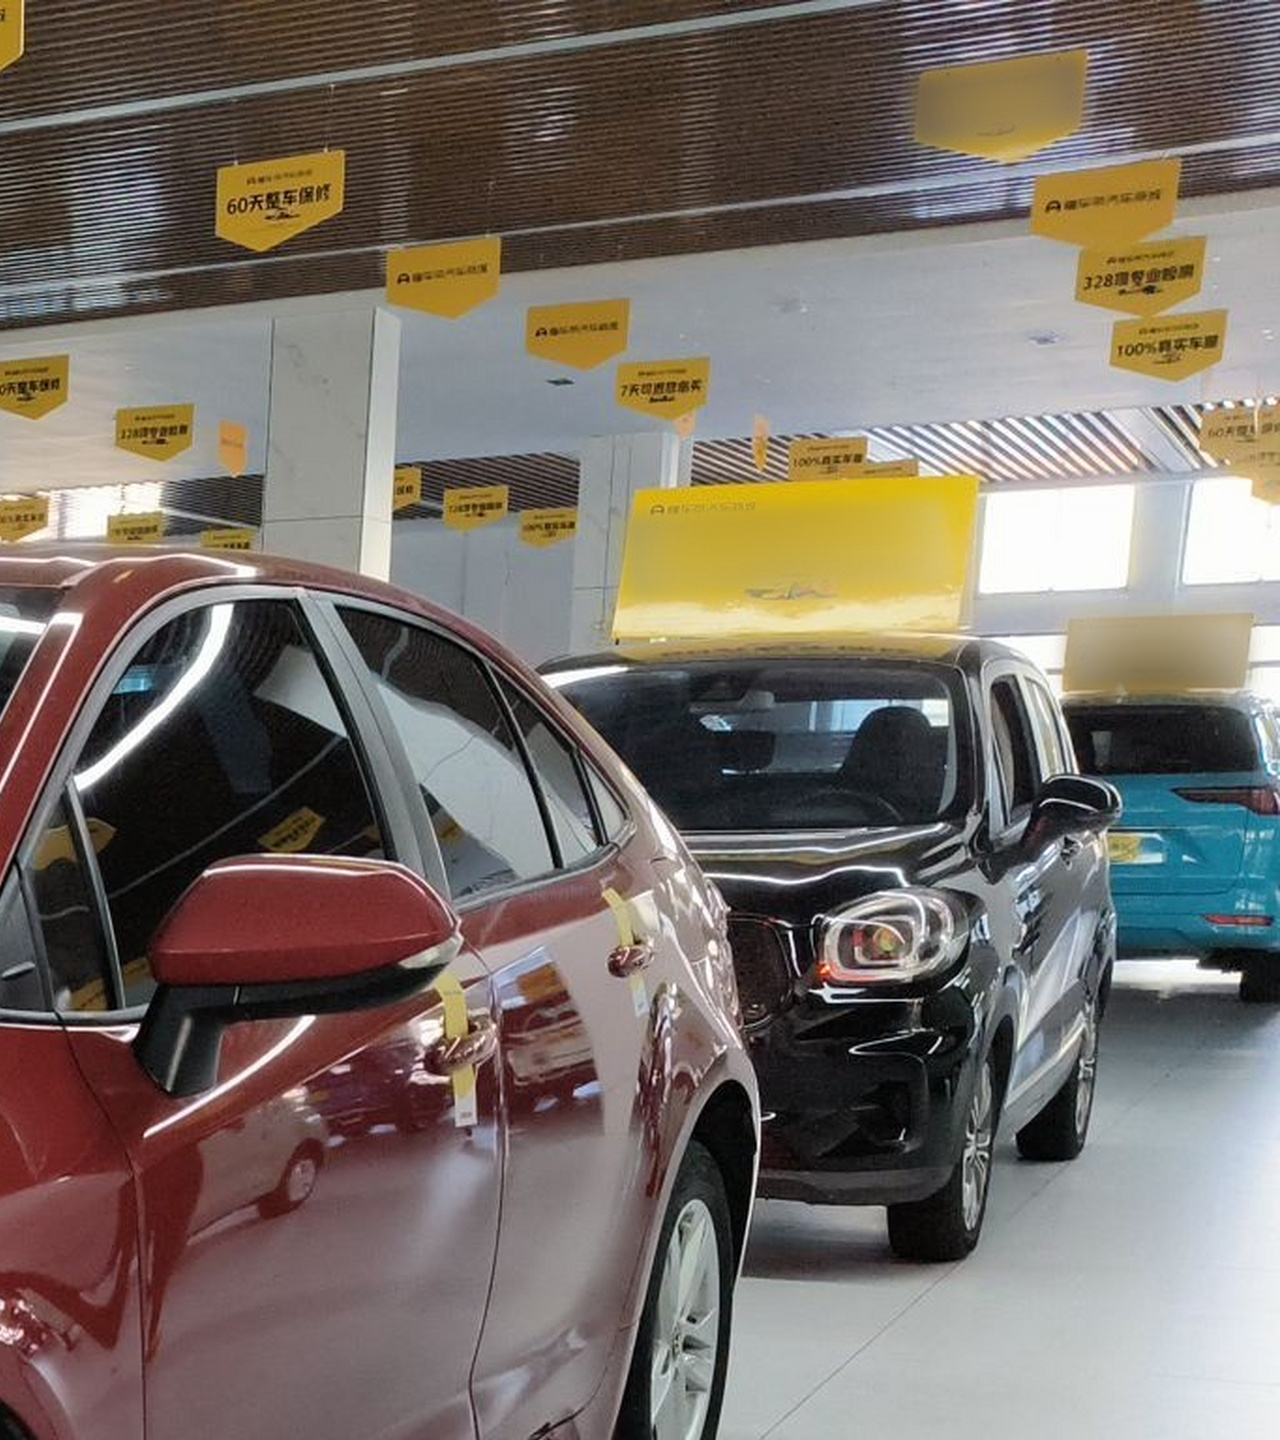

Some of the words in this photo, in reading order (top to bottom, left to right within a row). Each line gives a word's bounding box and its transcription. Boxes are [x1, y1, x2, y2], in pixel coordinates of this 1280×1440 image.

[226, 183, 332, 215] 60天整车保修
